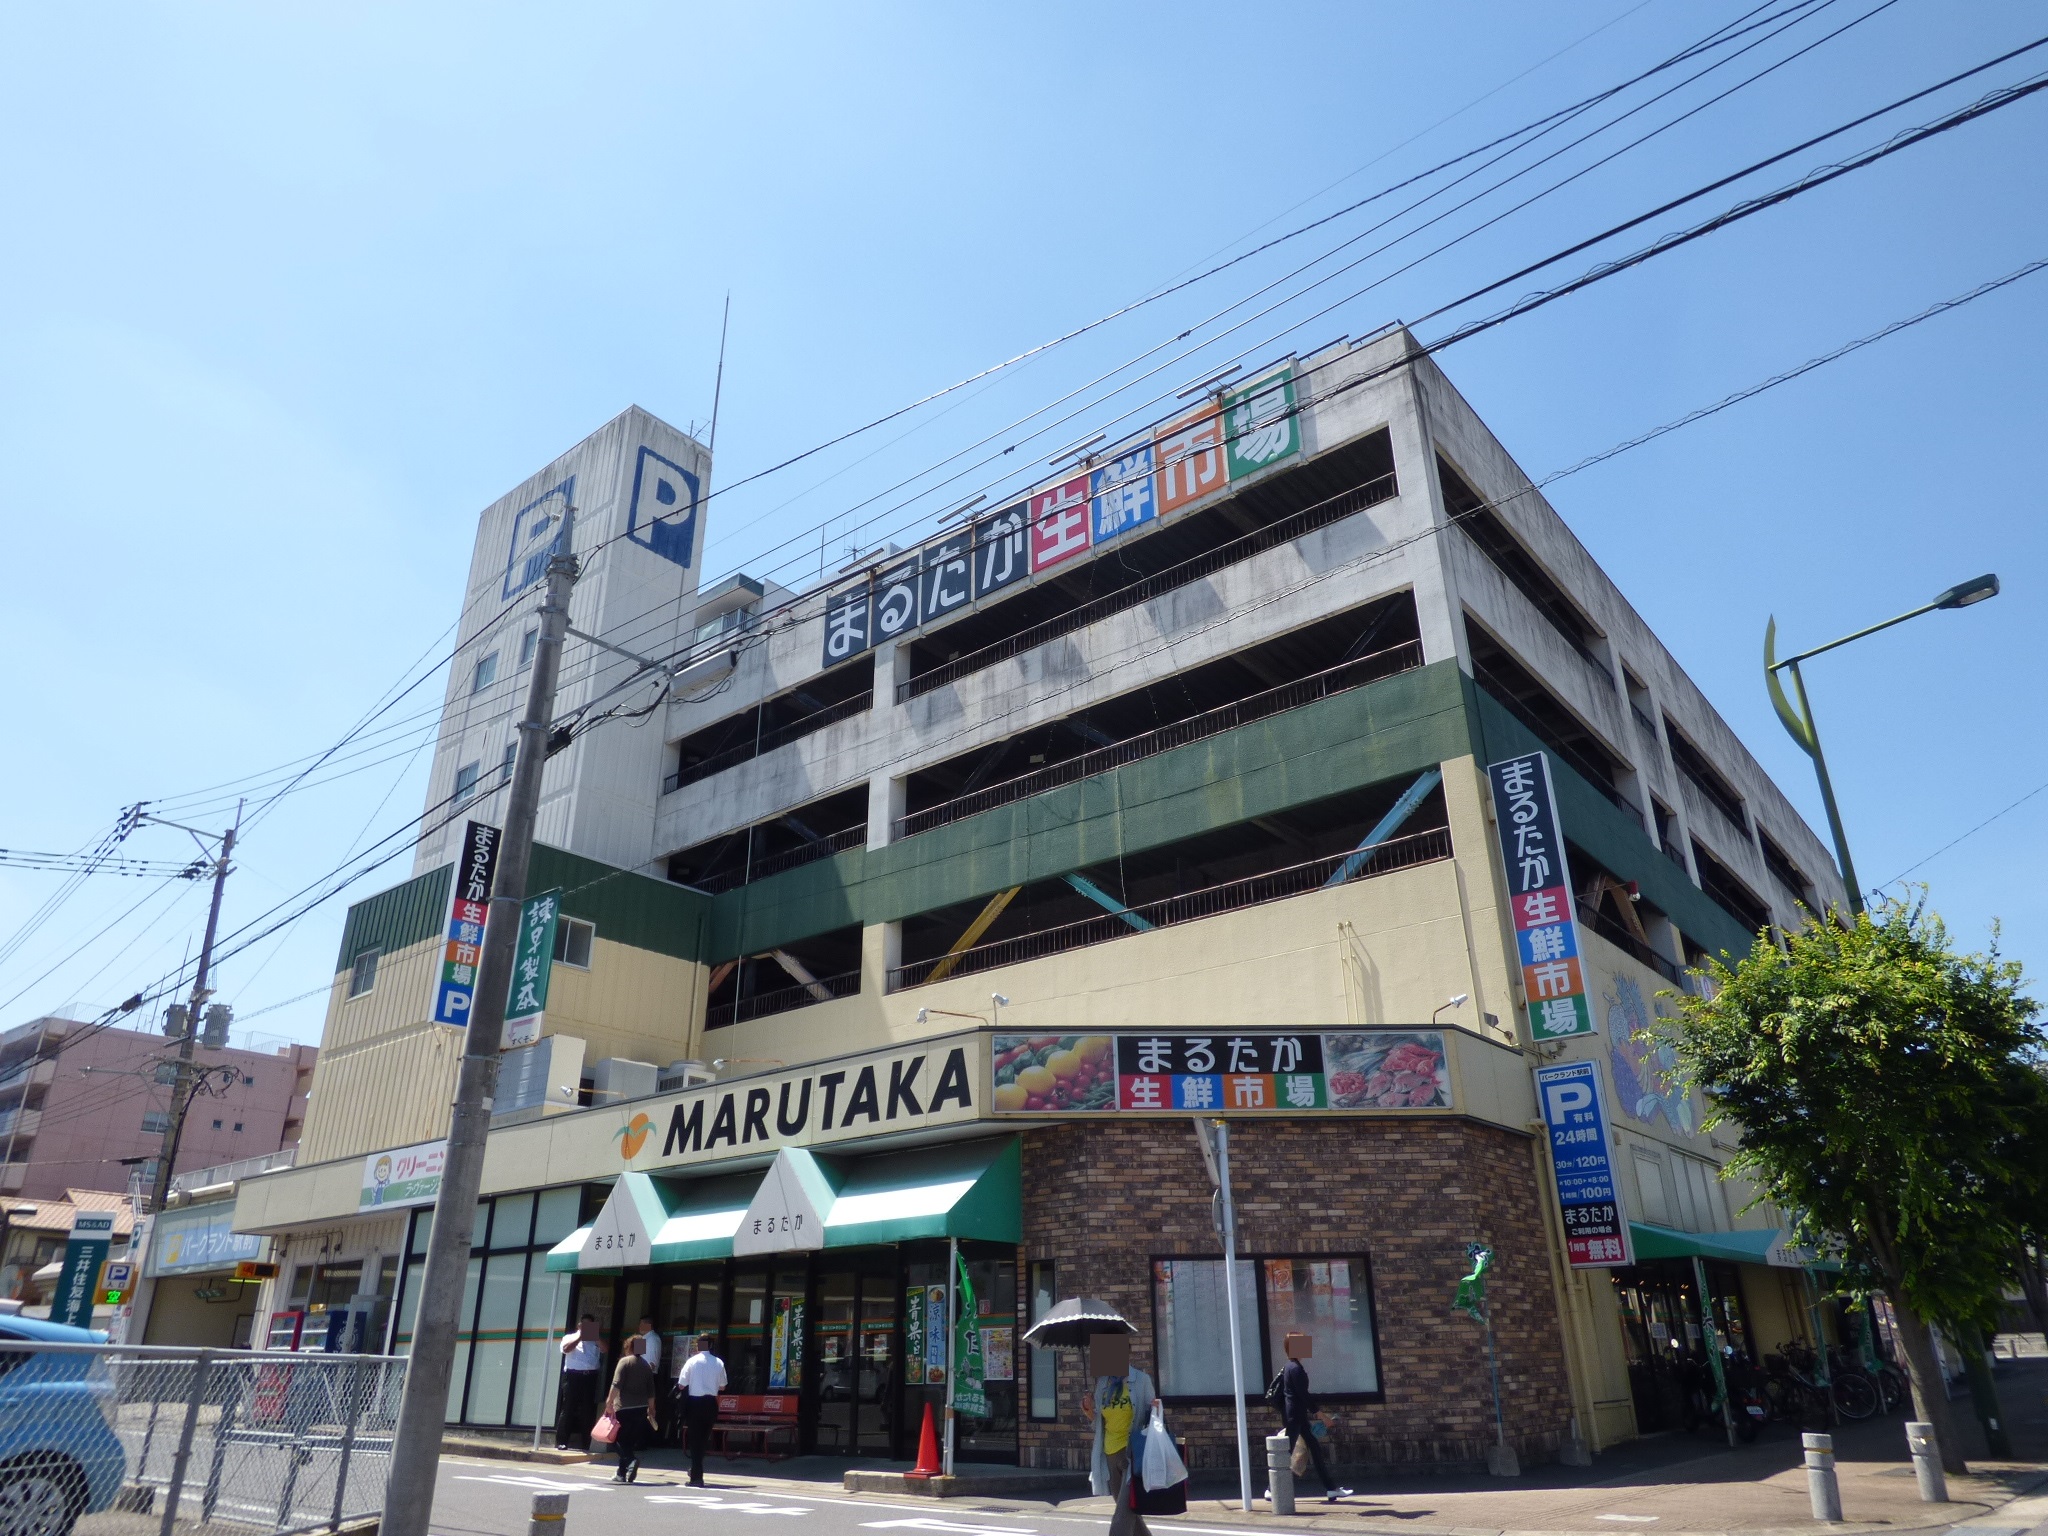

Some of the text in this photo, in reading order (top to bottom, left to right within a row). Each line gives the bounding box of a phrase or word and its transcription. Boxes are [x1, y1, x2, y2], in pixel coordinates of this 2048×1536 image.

[633, 452, 692, 546] P
[827, 388, 1292, 658] まるたか生鮮市場
[451, 825, 495, 986] まるたか生鮮市場
[1501, 760, 1578, 1035] まるたか生鮮市場
[443, 990, 471, 1018] P
[1137, 1037, 1303, 1074] まるたか
[1541, 1067, 1590, 1081] パークランド駅前
[662, 1047, 973, 1157] MARUTAKA
[1130, 1075, 1317, 1109] 生鮮市場
[1546, 1082, 1593, 1126] P
[1573, 1111, 1594, 1124] 有料
[1555, 1128, 1598, 1146] 24時間
[77, 1220, 110, 1229] MS&AD
[753, 1214, 803, 1235] まるたか
[1564, 1205, 1614, 1225] まるたか
[594, 1233, 636, 1251] まるたか
[1571, 1225, 1613, 1236] ご利用の場合
[63, 1246, 95, 1326] 三井住友海上
[105, 1290, 122, 1304] 空
